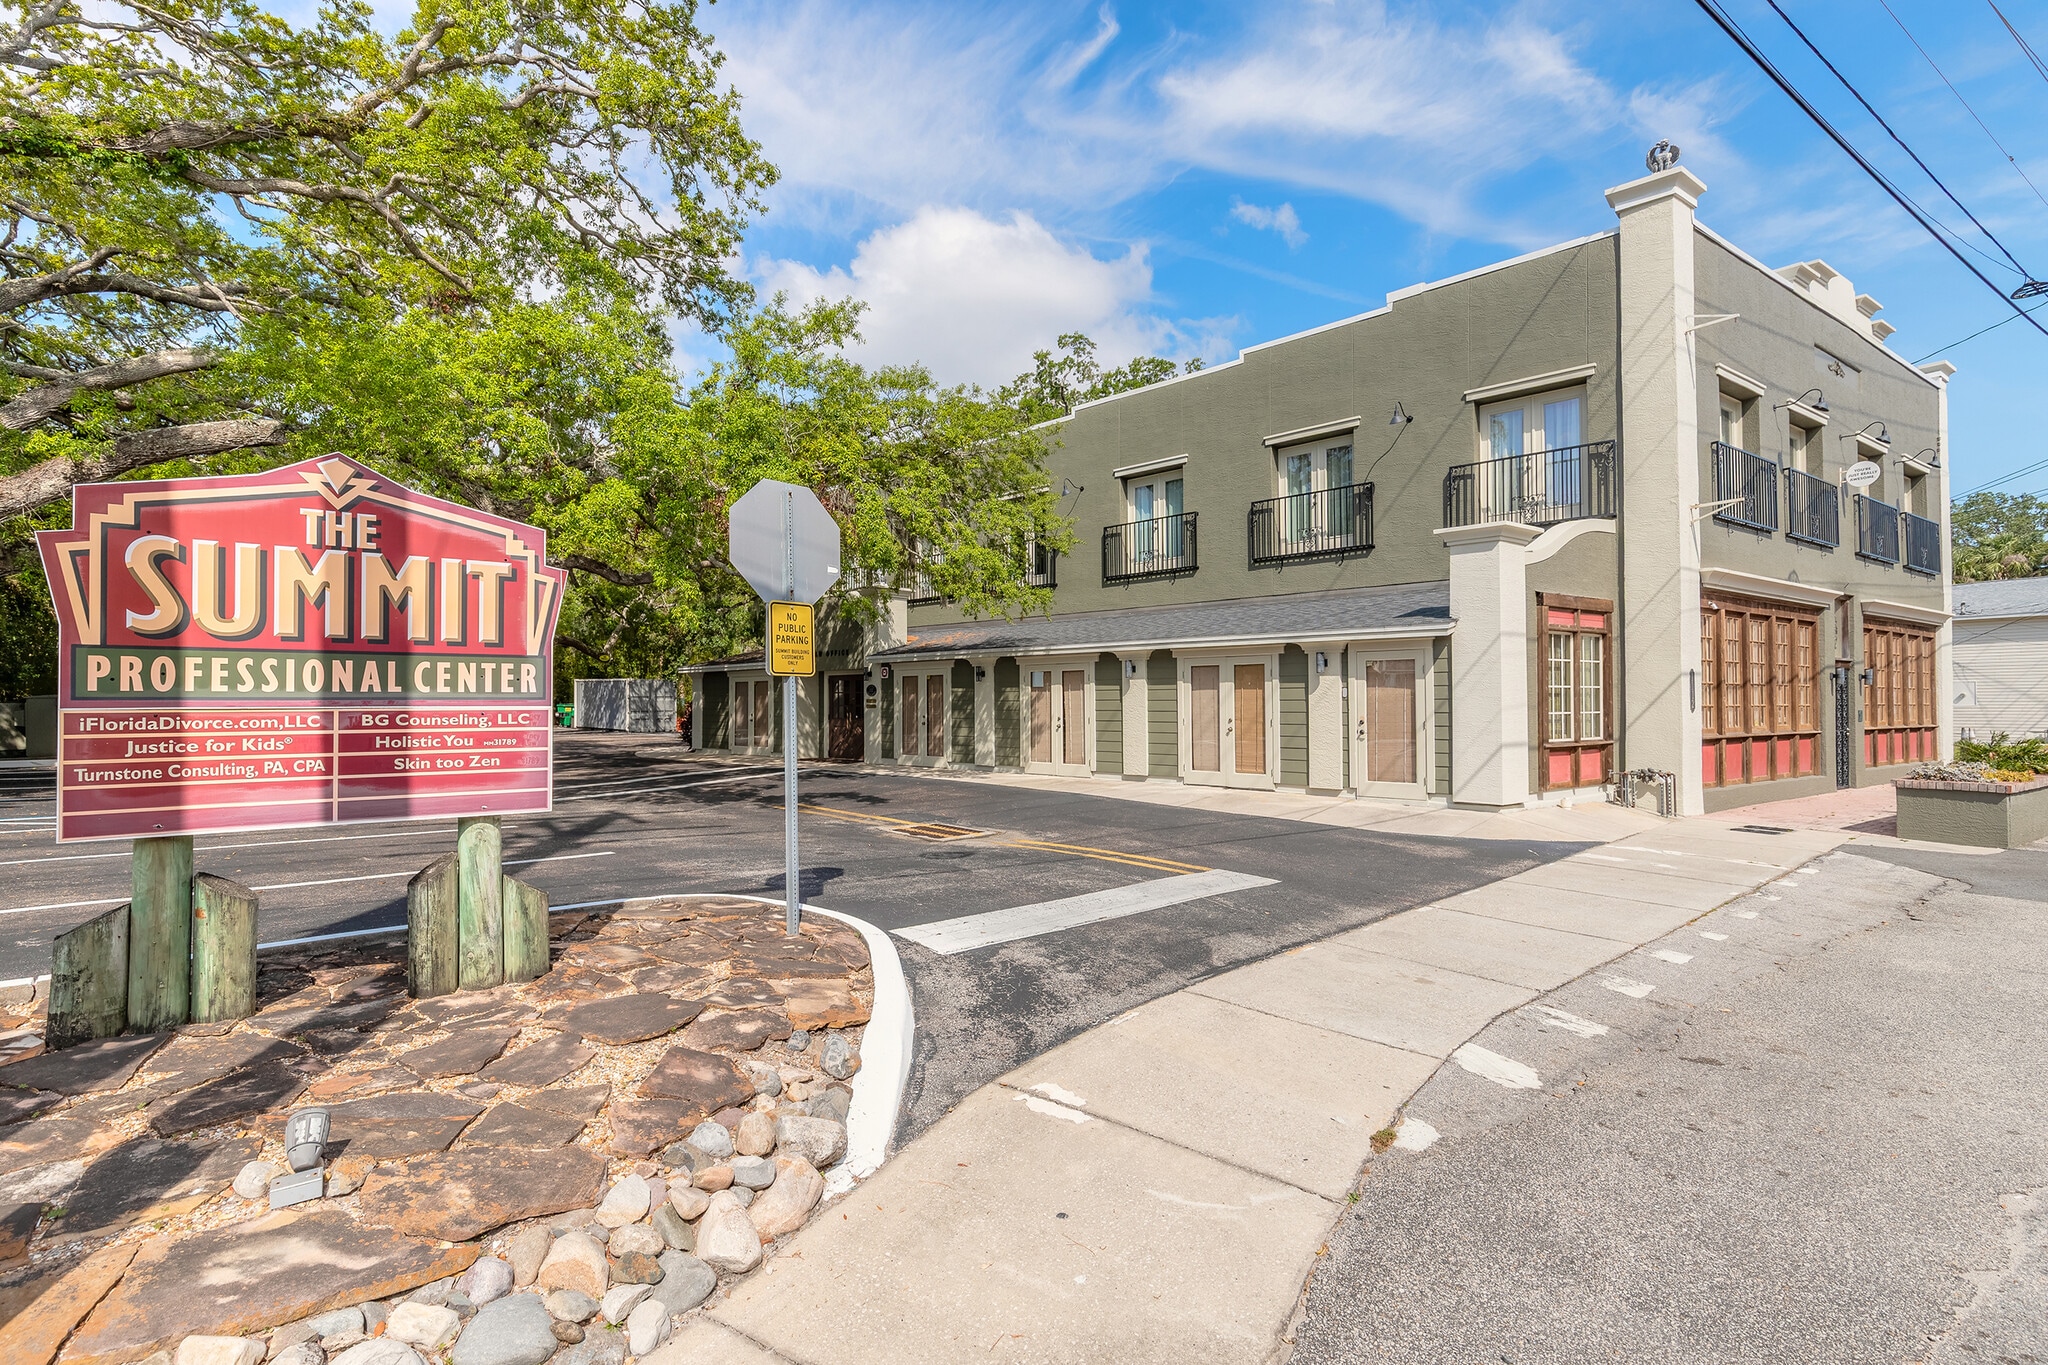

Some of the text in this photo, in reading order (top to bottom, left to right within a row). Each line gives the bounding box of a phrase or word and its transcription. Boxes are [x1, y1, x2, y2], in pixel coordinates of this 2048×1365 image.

[299, 507, 380, 550] THE
[124, 534, 515, 646] SUMMIT
[786, 612, 798, 621] NO
[778, 623, 806, 633] PUBLIC
[775, 634, 809, 645] PARKING
[86, 654, 537, 694] PROFESSIONAL CENTER
[361, 713, 389, 727] BG
[395, 713, 492, 729] Counseling,
[497, 713, 530, 725] LLC
[124, 739, 199, 758] Justice
[205, 738, 236, 753] for
[375, 735, 441, 749] Holistic
[443, 734, 474, 747] You
[74, 759, 326, 782] Turnstone Consulting, PA, CPA
[393, 755, 500, 771] Skin too Zen
